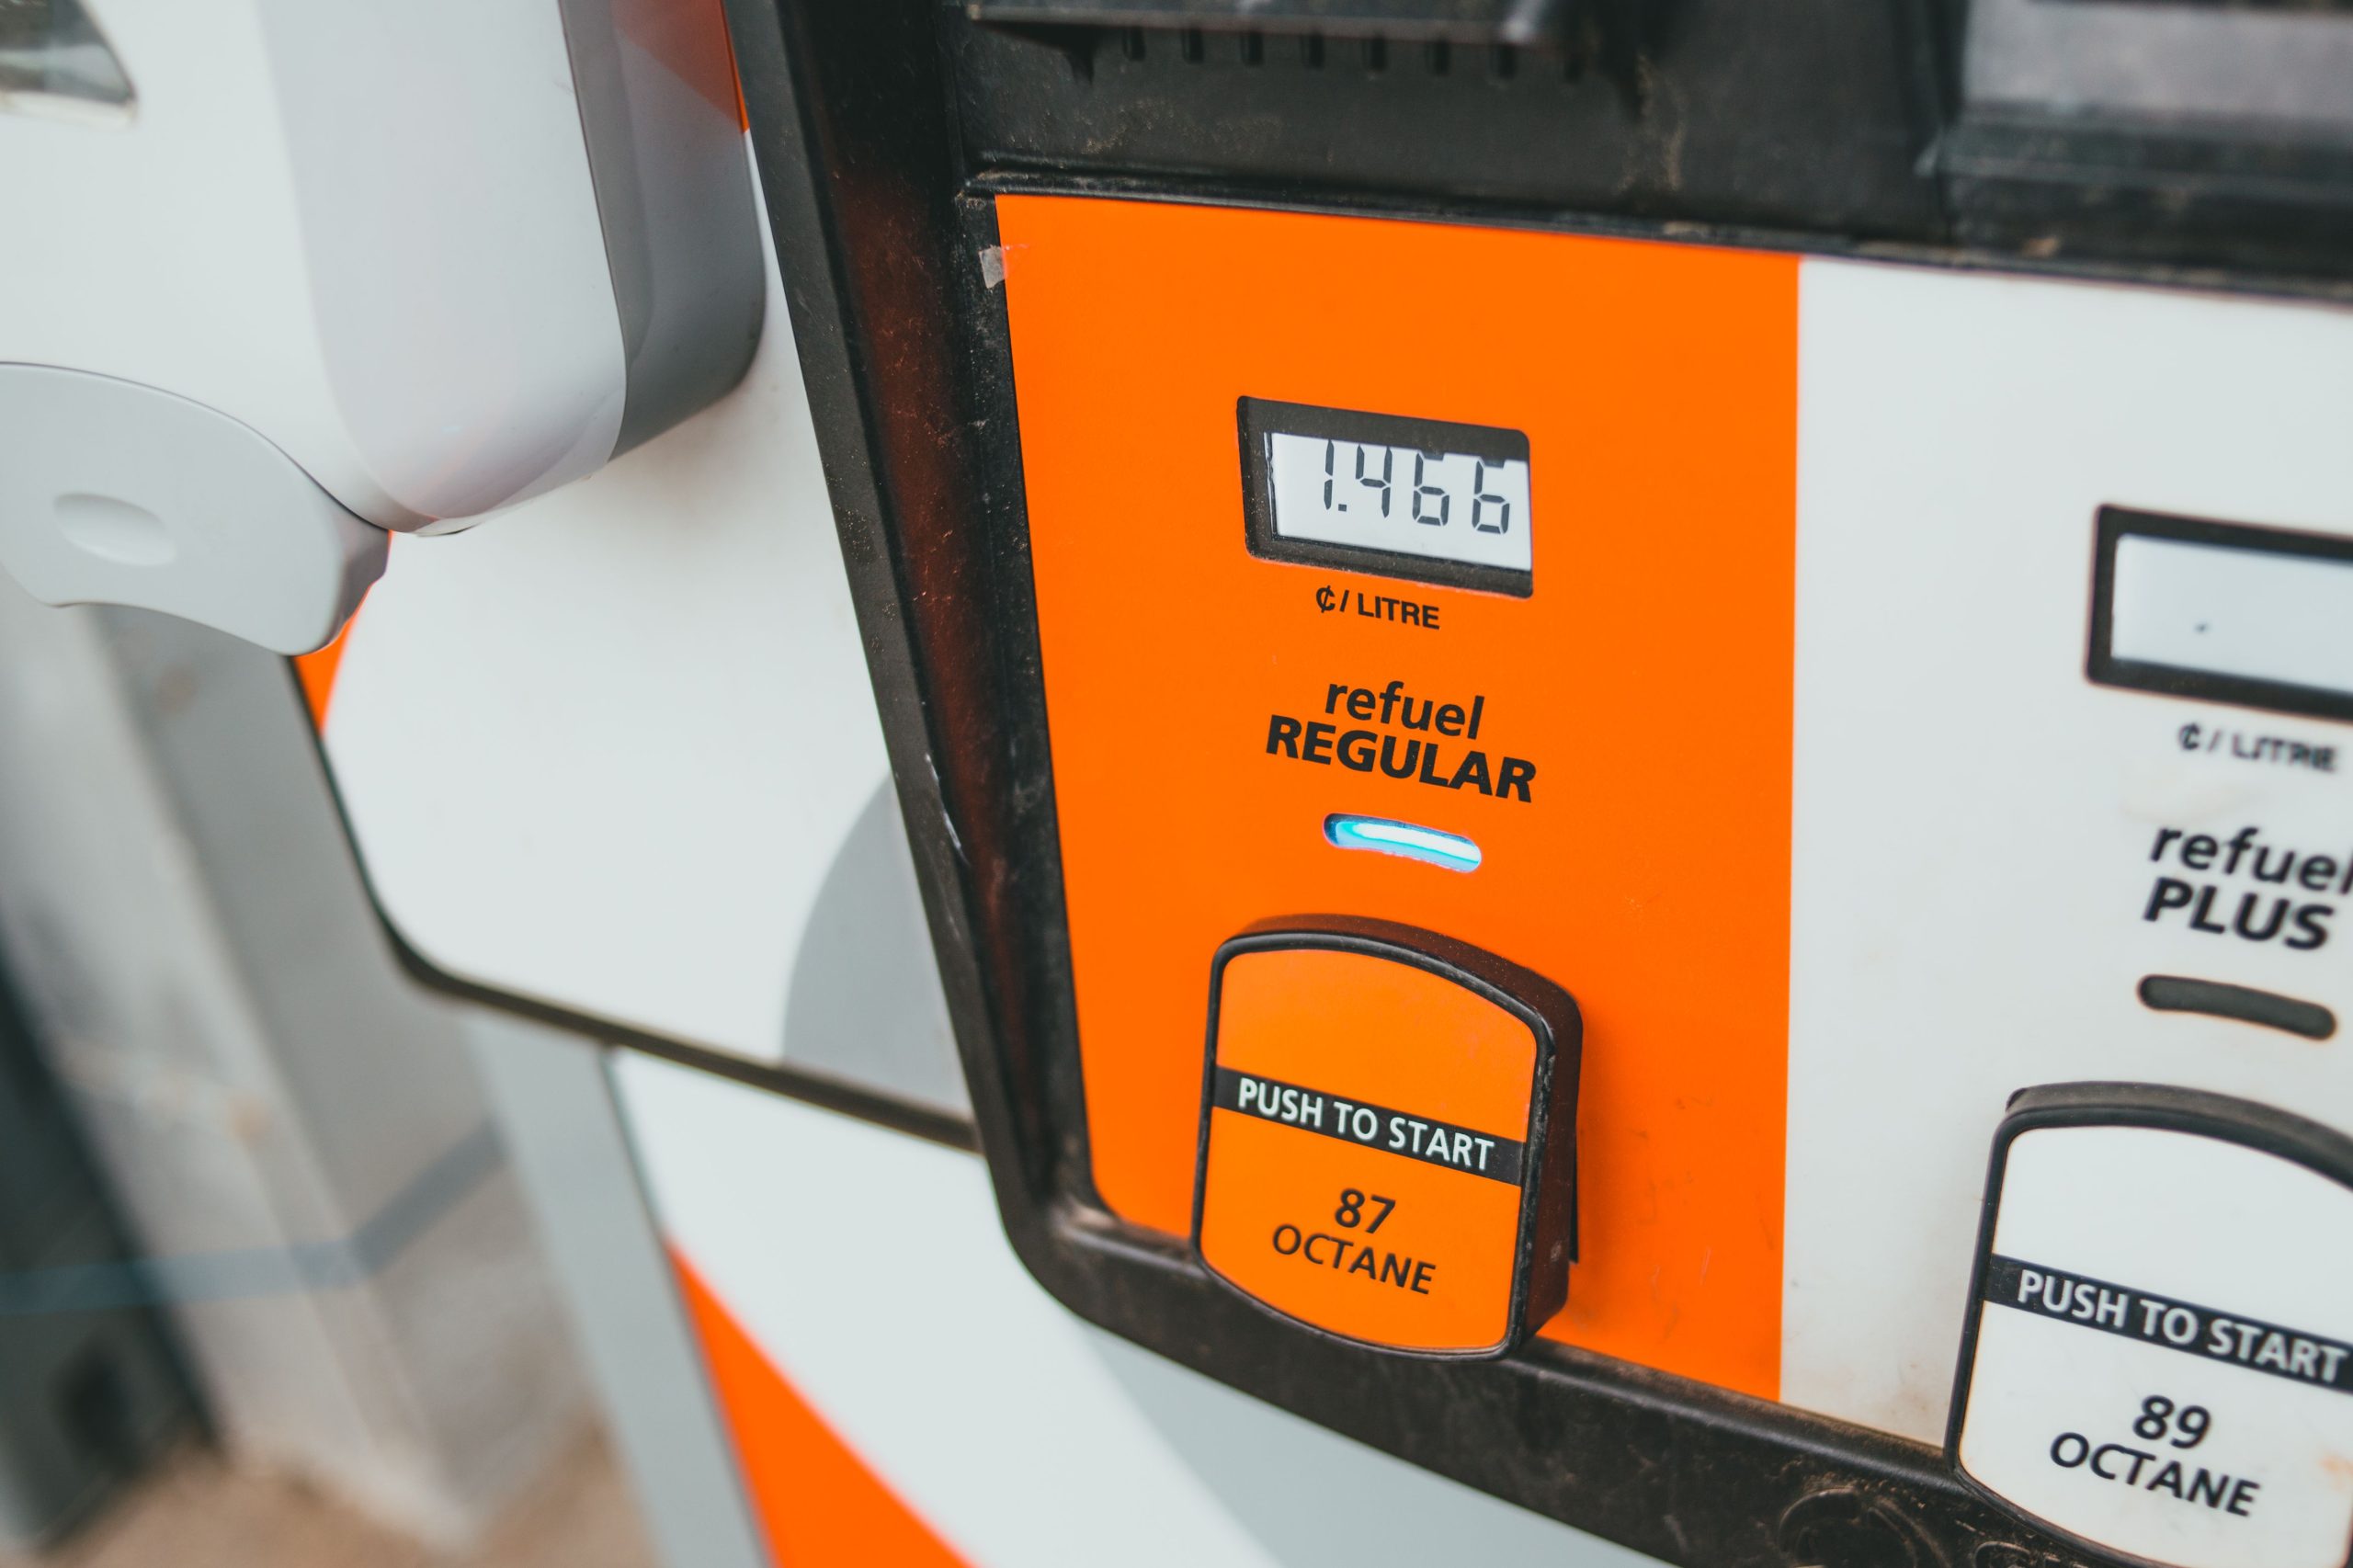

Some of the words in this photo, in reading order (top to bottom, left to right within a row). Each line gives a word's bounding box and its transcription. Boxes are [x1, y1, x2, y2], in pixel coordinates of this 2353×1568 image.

[1324, 439, 1510, 535] 1.466
[1357, 593, 1440, 630] LITRE
[1324, 680, 1485, 740] refuel
[1266, 714, 1537, 803] REGULAR
[2231, 733, 2339, 773] LITRE
[2143, 876, 2336, 950] PLUS
[1238, 1077, 1323, 1128] PUSH
[1333, 1100, 1379, 1142] TO
[1388, 1117, 1495, 1171] START
[1334, 1187, 1396, 1234] 87
[1272, 1223, 1437, 1295] OCTANE
[2016, 1269, 2130, 1328] PUSH
[2139, 1298, 2200, 1346] TO
[2206, 1317, 2348, 1383] START
[2131, 1394, 2212, 1449] 89
[2049, 1431, 2261, 1517] OCTANE
